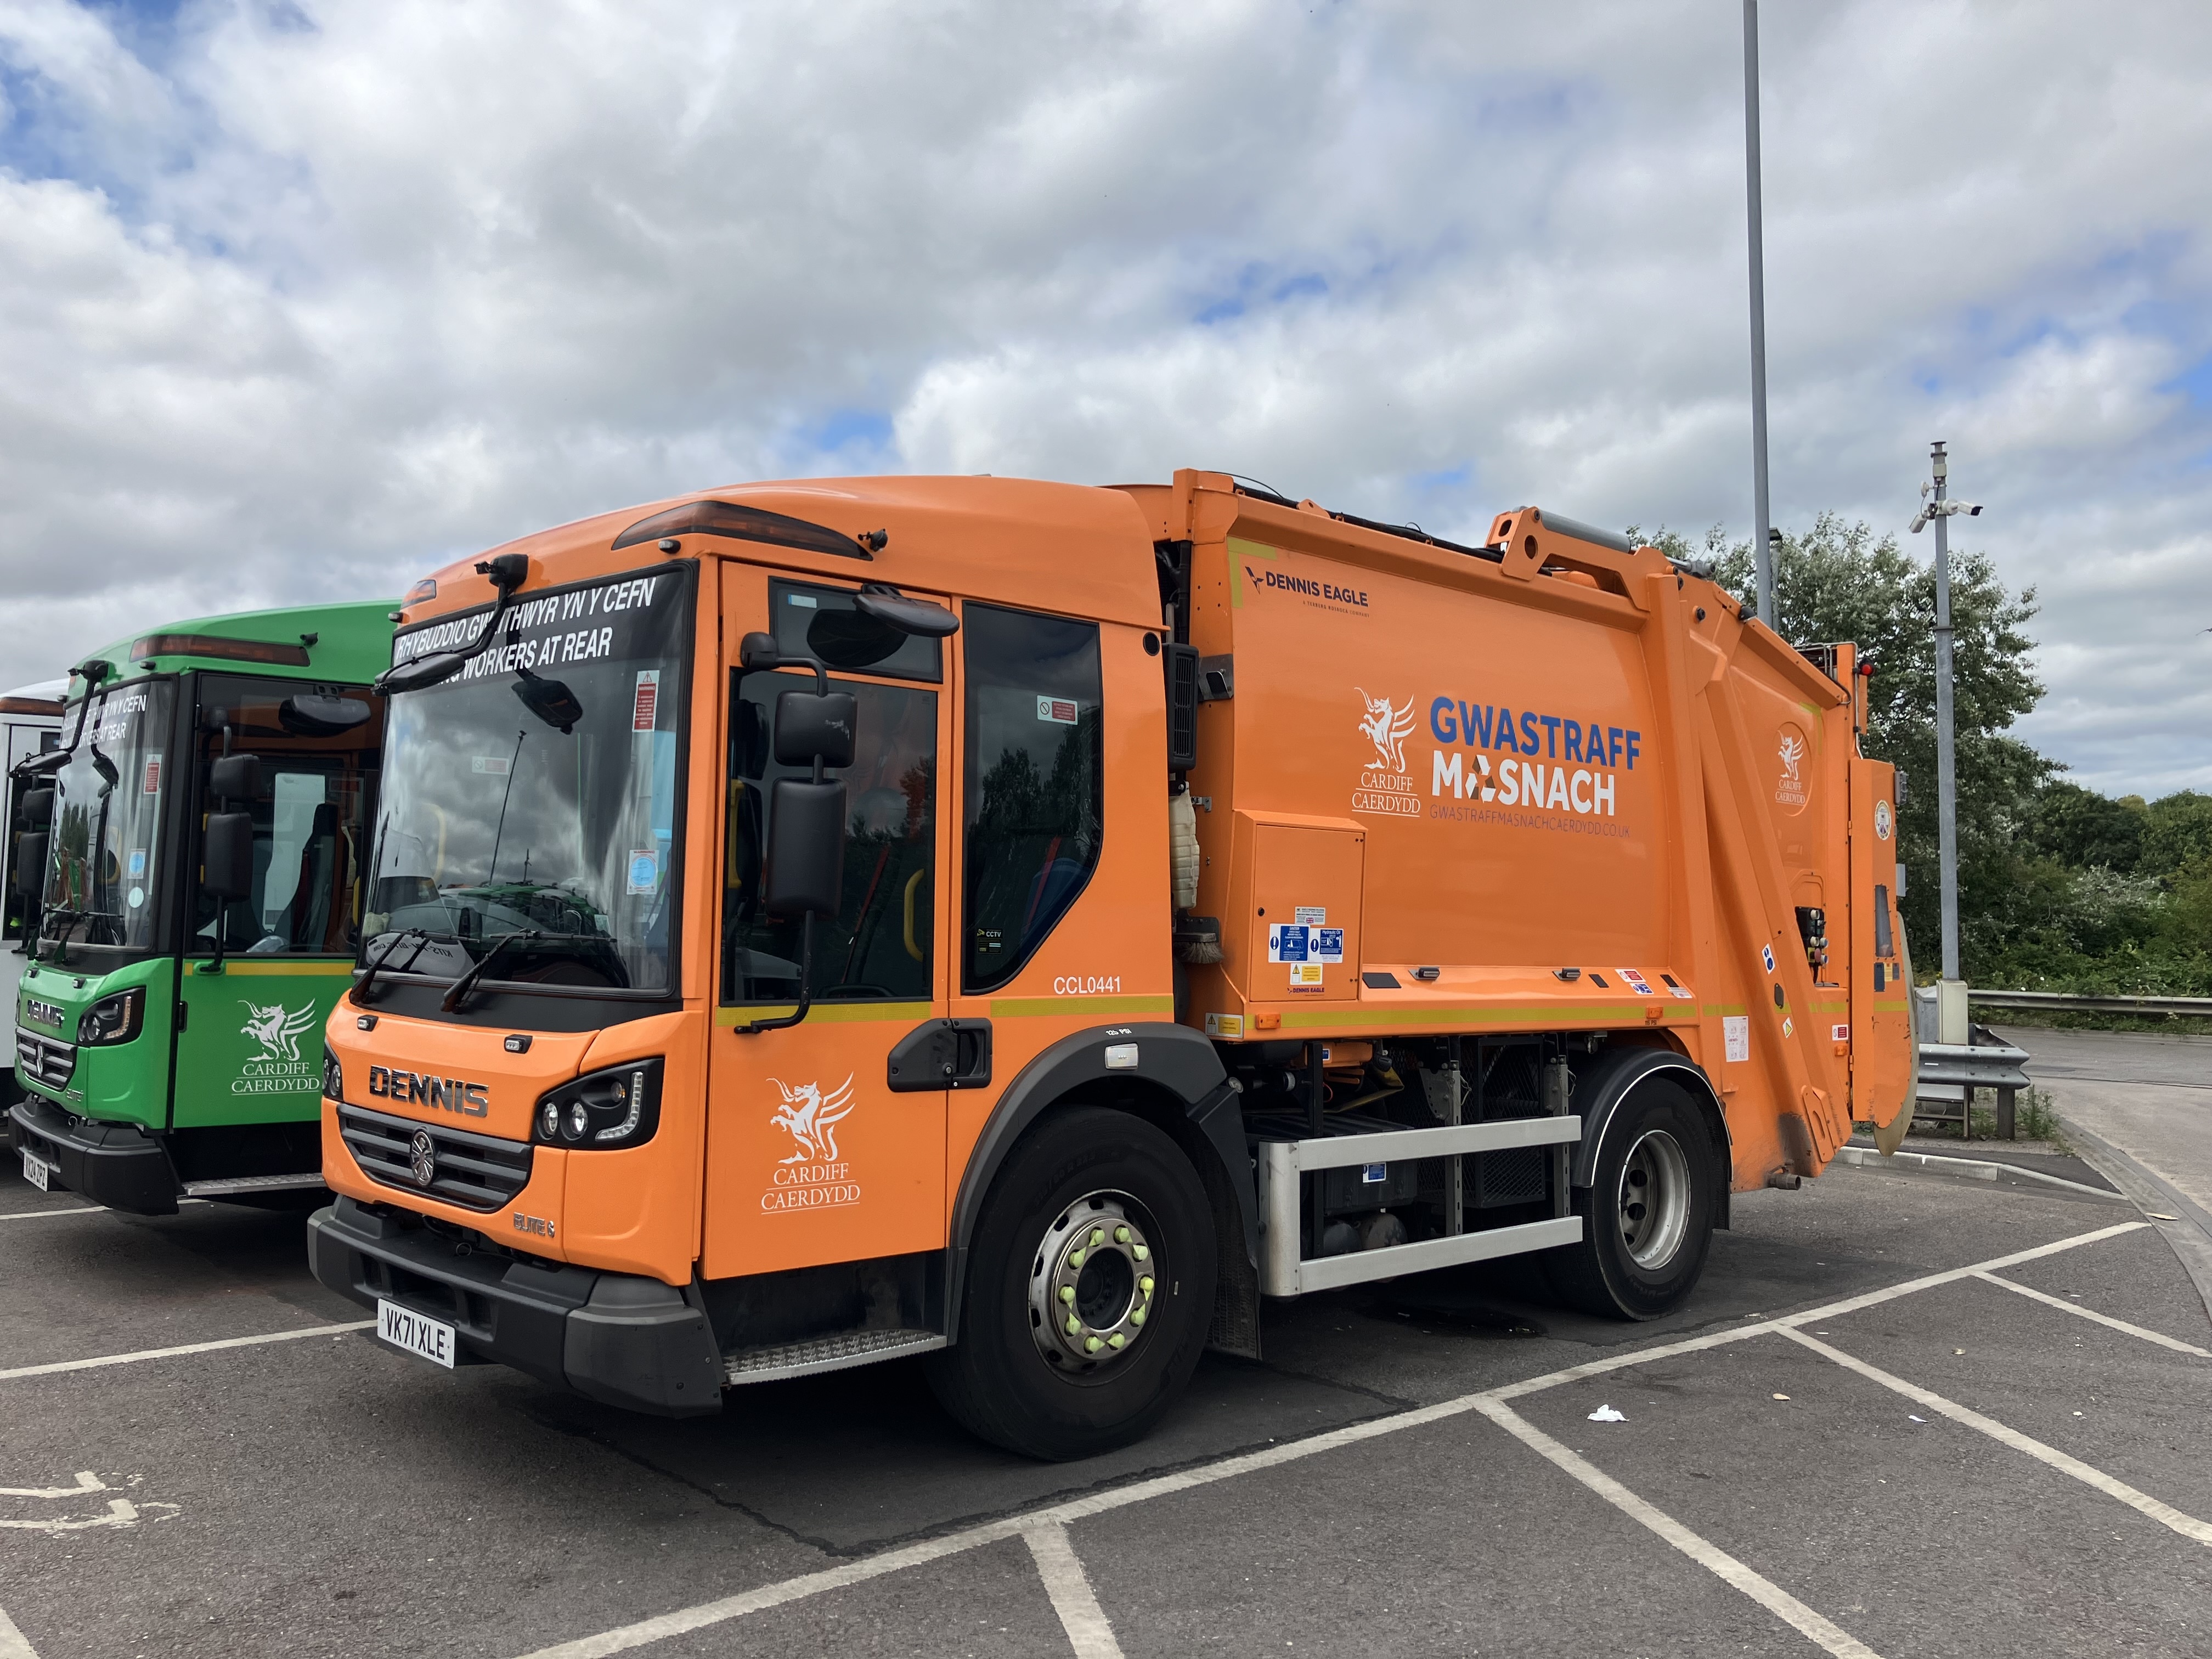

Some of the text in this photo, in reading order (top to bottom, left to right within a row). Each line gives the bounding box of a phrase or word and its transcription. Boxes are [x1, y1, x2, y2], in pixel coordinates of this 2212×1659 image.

[1266, 571, 1368, 607] DENNIS EAGLE
[396, 577, 657, 659] RHYBUDDIO GWITHWYR YN Y CEFN
[1350, 610, 1369, 618] COMPANY
[464, 627, 613, 680] WORKERS AT REAR
[123, 694, 147, 713] CEFN
[107, 722, 127, 741] REAR
[1430, 696, 1640, 770] GWASTRAFF
[1361, 772, 1413, 792] CARDIFF
[1779, 779, 1802, 791] CARDIFF
[1352, 792, 1420, 814] CAERDYDD
[1775, 791, 1805, 804] CAERDYDD
[1430, 804, 1631, 838] GWASTRAFFMASNACHCAERDYDD.CO.UK
[1053, 976, 1120, 995] CCL0441
[242, 1062, 310, 1076] CARDIFF
[232, 1077, 320, 1093] CAERDYDD
[369, 1064, 489, 1118] DENNIS
[36, 1163, 46, 1187] ZPZ
[774, 1163, 849, 1185] CARDIFF
[761, 1184, 861, 1210] CAERDYDD
[514, 1211, 555, 1238] ELITE 6
[386, 1307, 445, 1361] VK71 XLE
